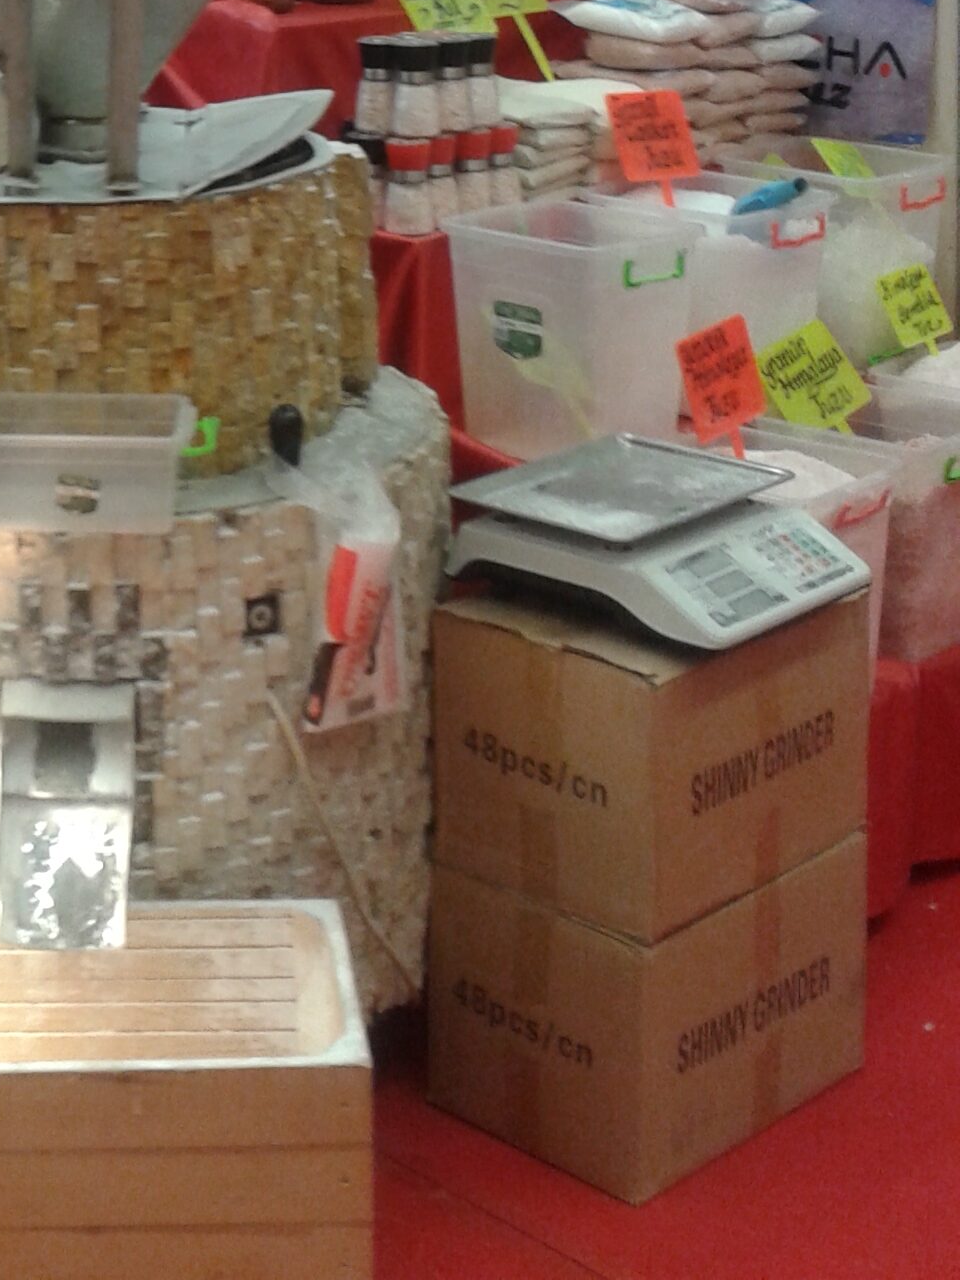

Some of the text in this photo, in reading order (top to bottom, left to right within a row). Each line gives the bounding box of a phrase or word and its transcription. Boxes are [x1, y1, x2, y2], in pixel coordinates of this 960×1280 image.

[464, 727, 609, 808] 48pcs/cn
[691, 709, 835, 816] SHINNY GRINDER
[452, 977, 594, 1068] 48pcs/cn
[676, 956, 830, 1074] SHINNY GRINDER
